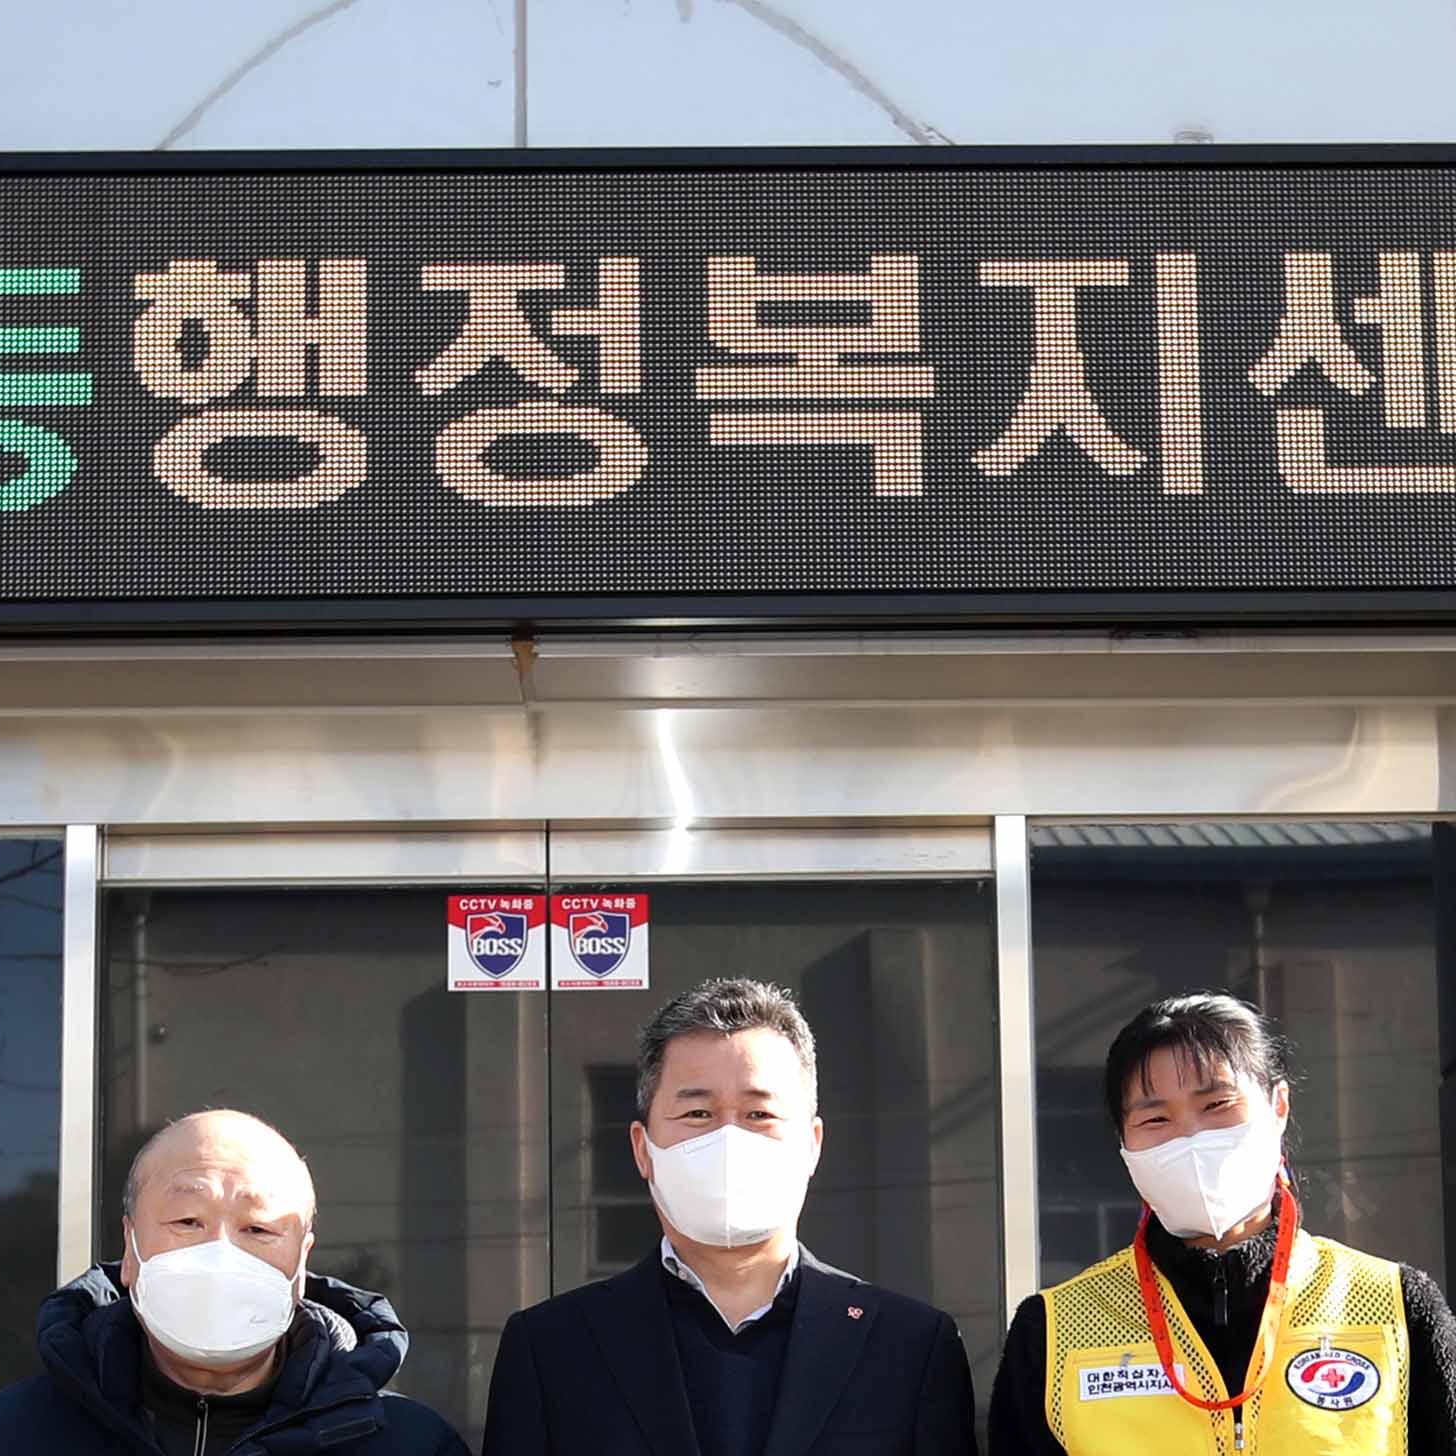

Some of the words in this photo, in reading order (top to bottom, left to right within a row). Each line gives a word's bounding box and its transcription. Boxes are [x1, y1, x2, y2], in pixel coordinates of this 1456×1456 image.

[459, 898, 496, 910] CCTV
[562, 898, 599, 910] CCTV
[472, 937, 523, 956] BOSS
[575, 936, 626, 955] BOSS
